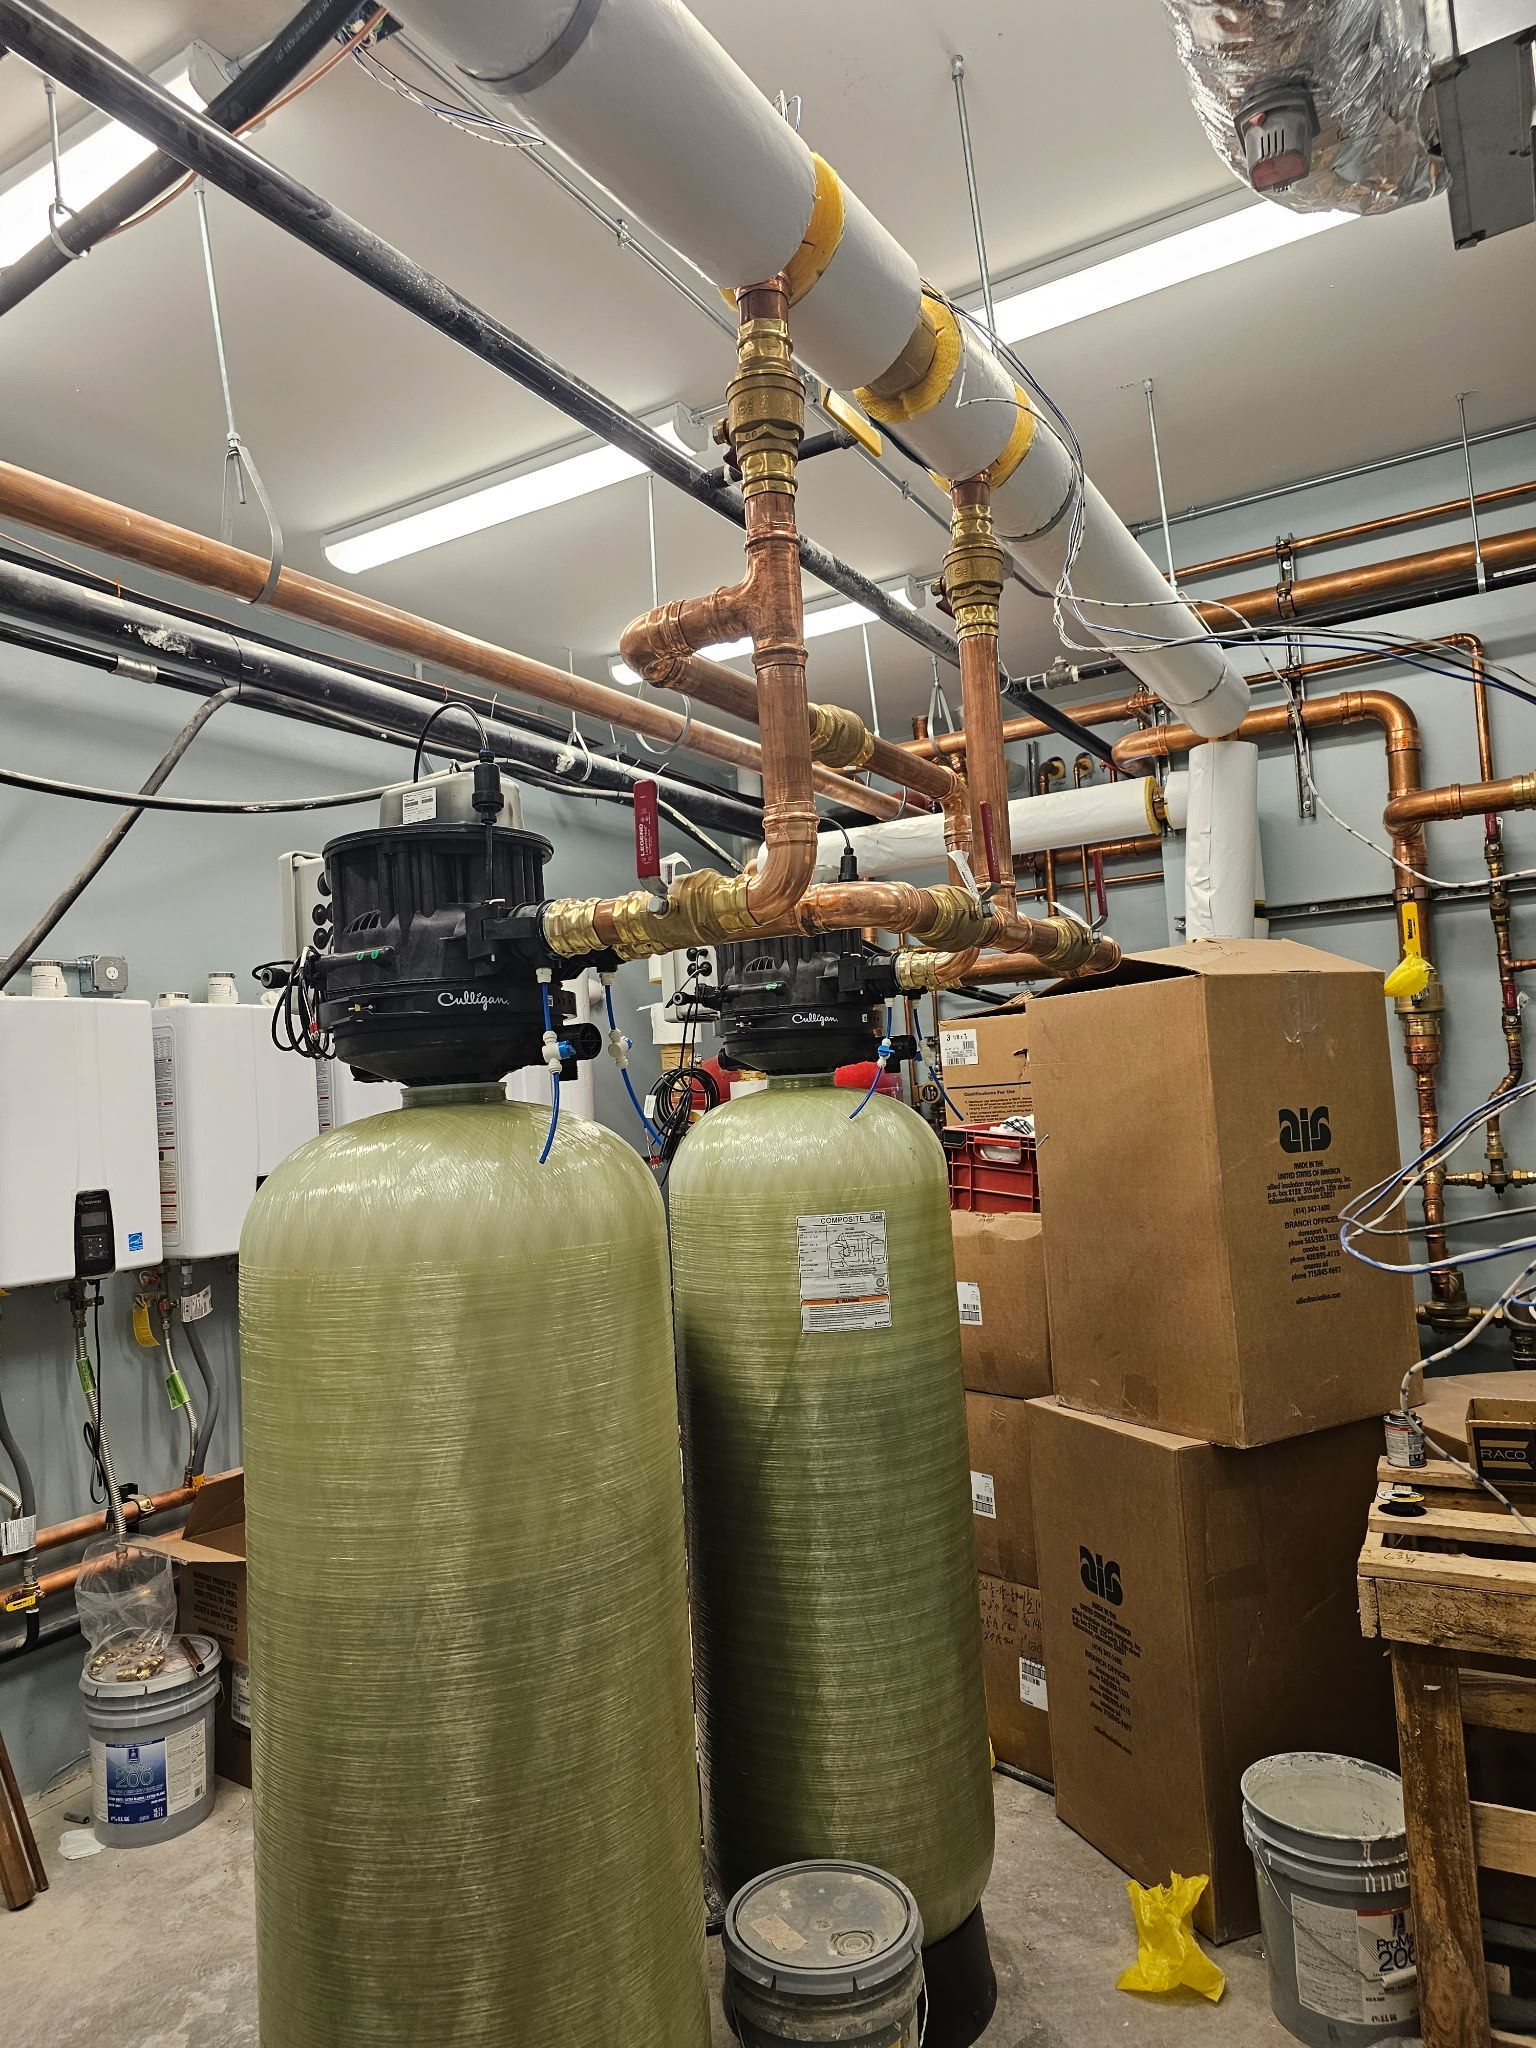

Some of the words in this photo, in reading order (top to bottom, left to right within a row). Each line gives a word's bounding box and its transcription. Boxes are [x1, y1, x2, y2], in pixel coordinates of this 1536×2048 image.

[1294, 1161, 1308, 1170] MADE
[1278, 1172, 1296, 1180] UNITED
[1296, 1170, 1312, 1178] STATES
[1320, 1168, 1340, 1176] AMERICA
[820, 1215, 864, 1224] COMPOSITE
[1284, 1219, 1312, 1229] BRANCH
[1313, 1216, 1340, 1226] OFFICES
[1480, 1450, 1527, 1460] RACO
[116, 1770, 153, 1788] 200
